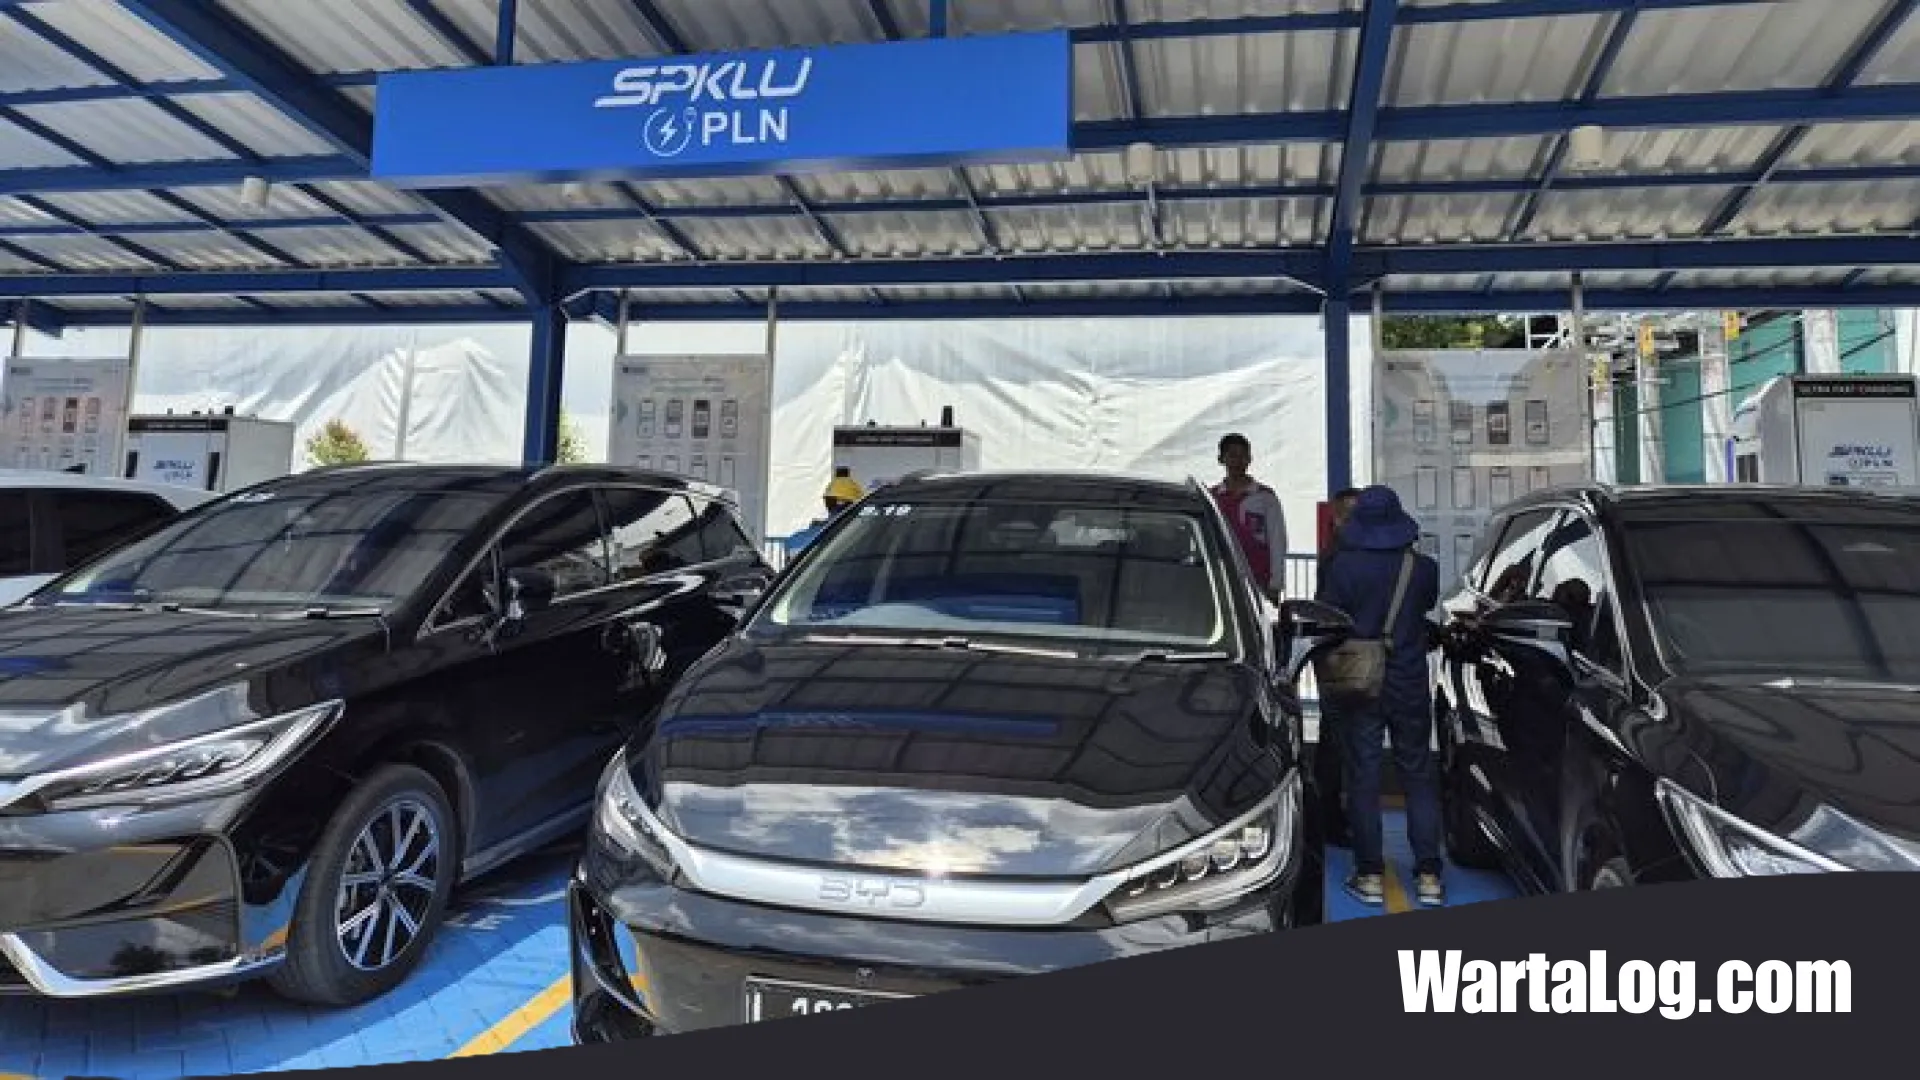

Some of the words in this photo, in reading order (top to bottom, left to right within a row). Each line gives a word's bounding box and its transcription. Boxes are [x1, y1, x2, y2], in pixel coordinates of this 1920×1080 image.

[593, 57, 812, 107] SPKLU
[701, 109, 788, 146] PLN
[819, 876, 926, 908] BYD
